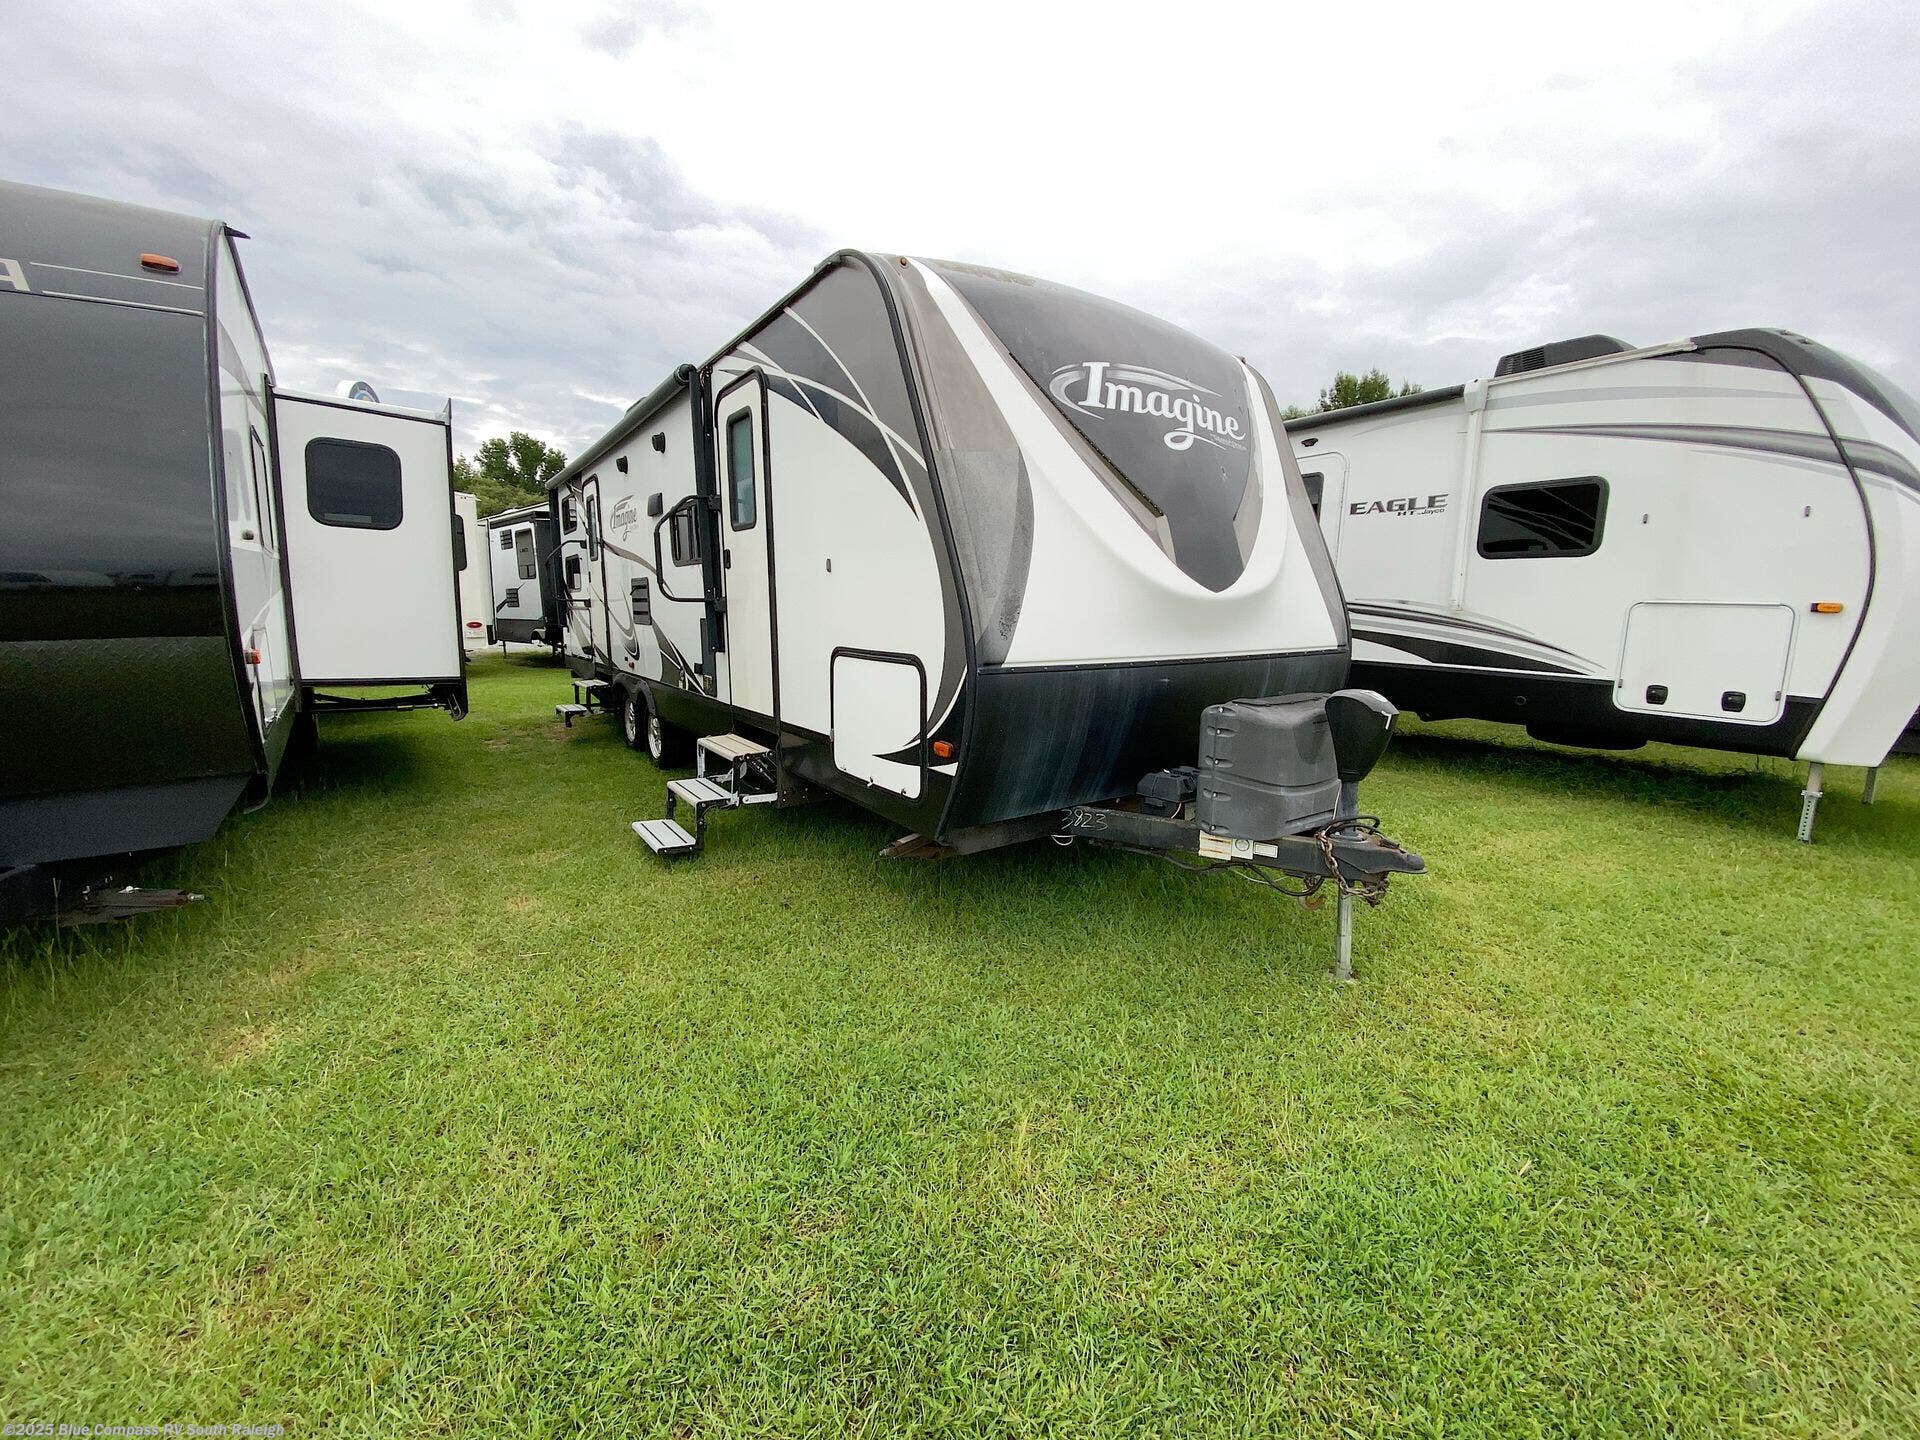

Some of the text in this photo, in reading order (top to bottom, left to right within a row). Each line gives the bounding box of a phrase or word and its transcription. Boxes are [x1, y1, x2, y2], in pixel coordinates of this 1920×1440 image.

[1078, 361, 1246, 451] Imagine
[1350, 494, 1449, 515] EAGLE
[613, 503, 637, 542] Imagine
[1060, 808, 1108, 831] 3823
